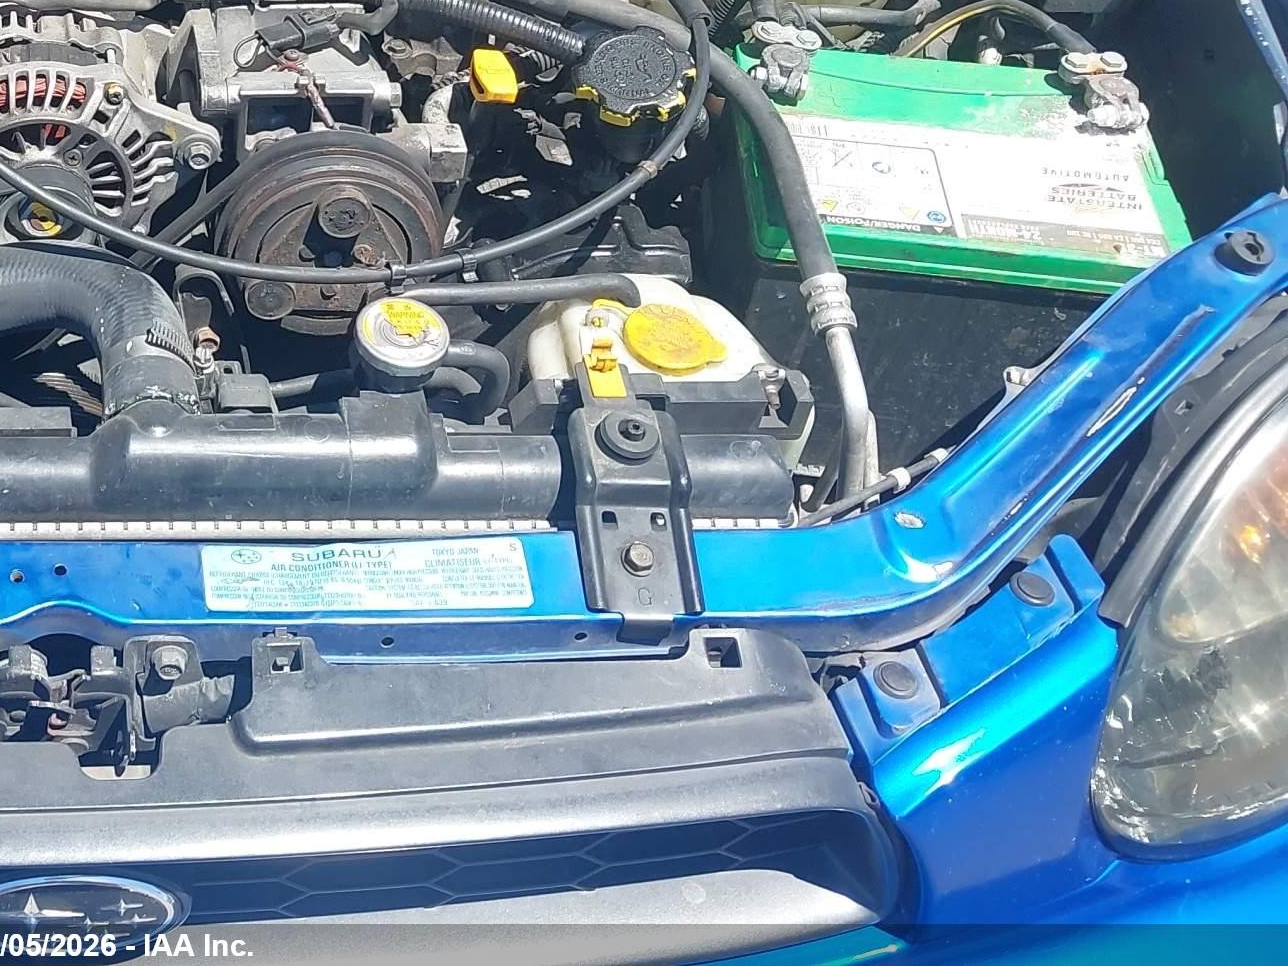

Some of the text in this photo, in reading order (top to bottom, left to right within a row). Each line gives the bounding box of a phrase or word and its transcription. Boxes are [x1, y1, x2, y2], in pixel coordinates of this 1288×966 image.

[1040, 166, 1129, 183] AUTOMOTIVE
[1046, 193, 1143, 212] INTERSTATE
[1050, 186, 1137, 203] BATTERIES
[826, 216, 921, 232] DANGER/POISON
[291, 548, 382, 562] SUBARU
[271, 563, 287, 572] AIR
[289, 561, 350, 572] CONDITIONER
